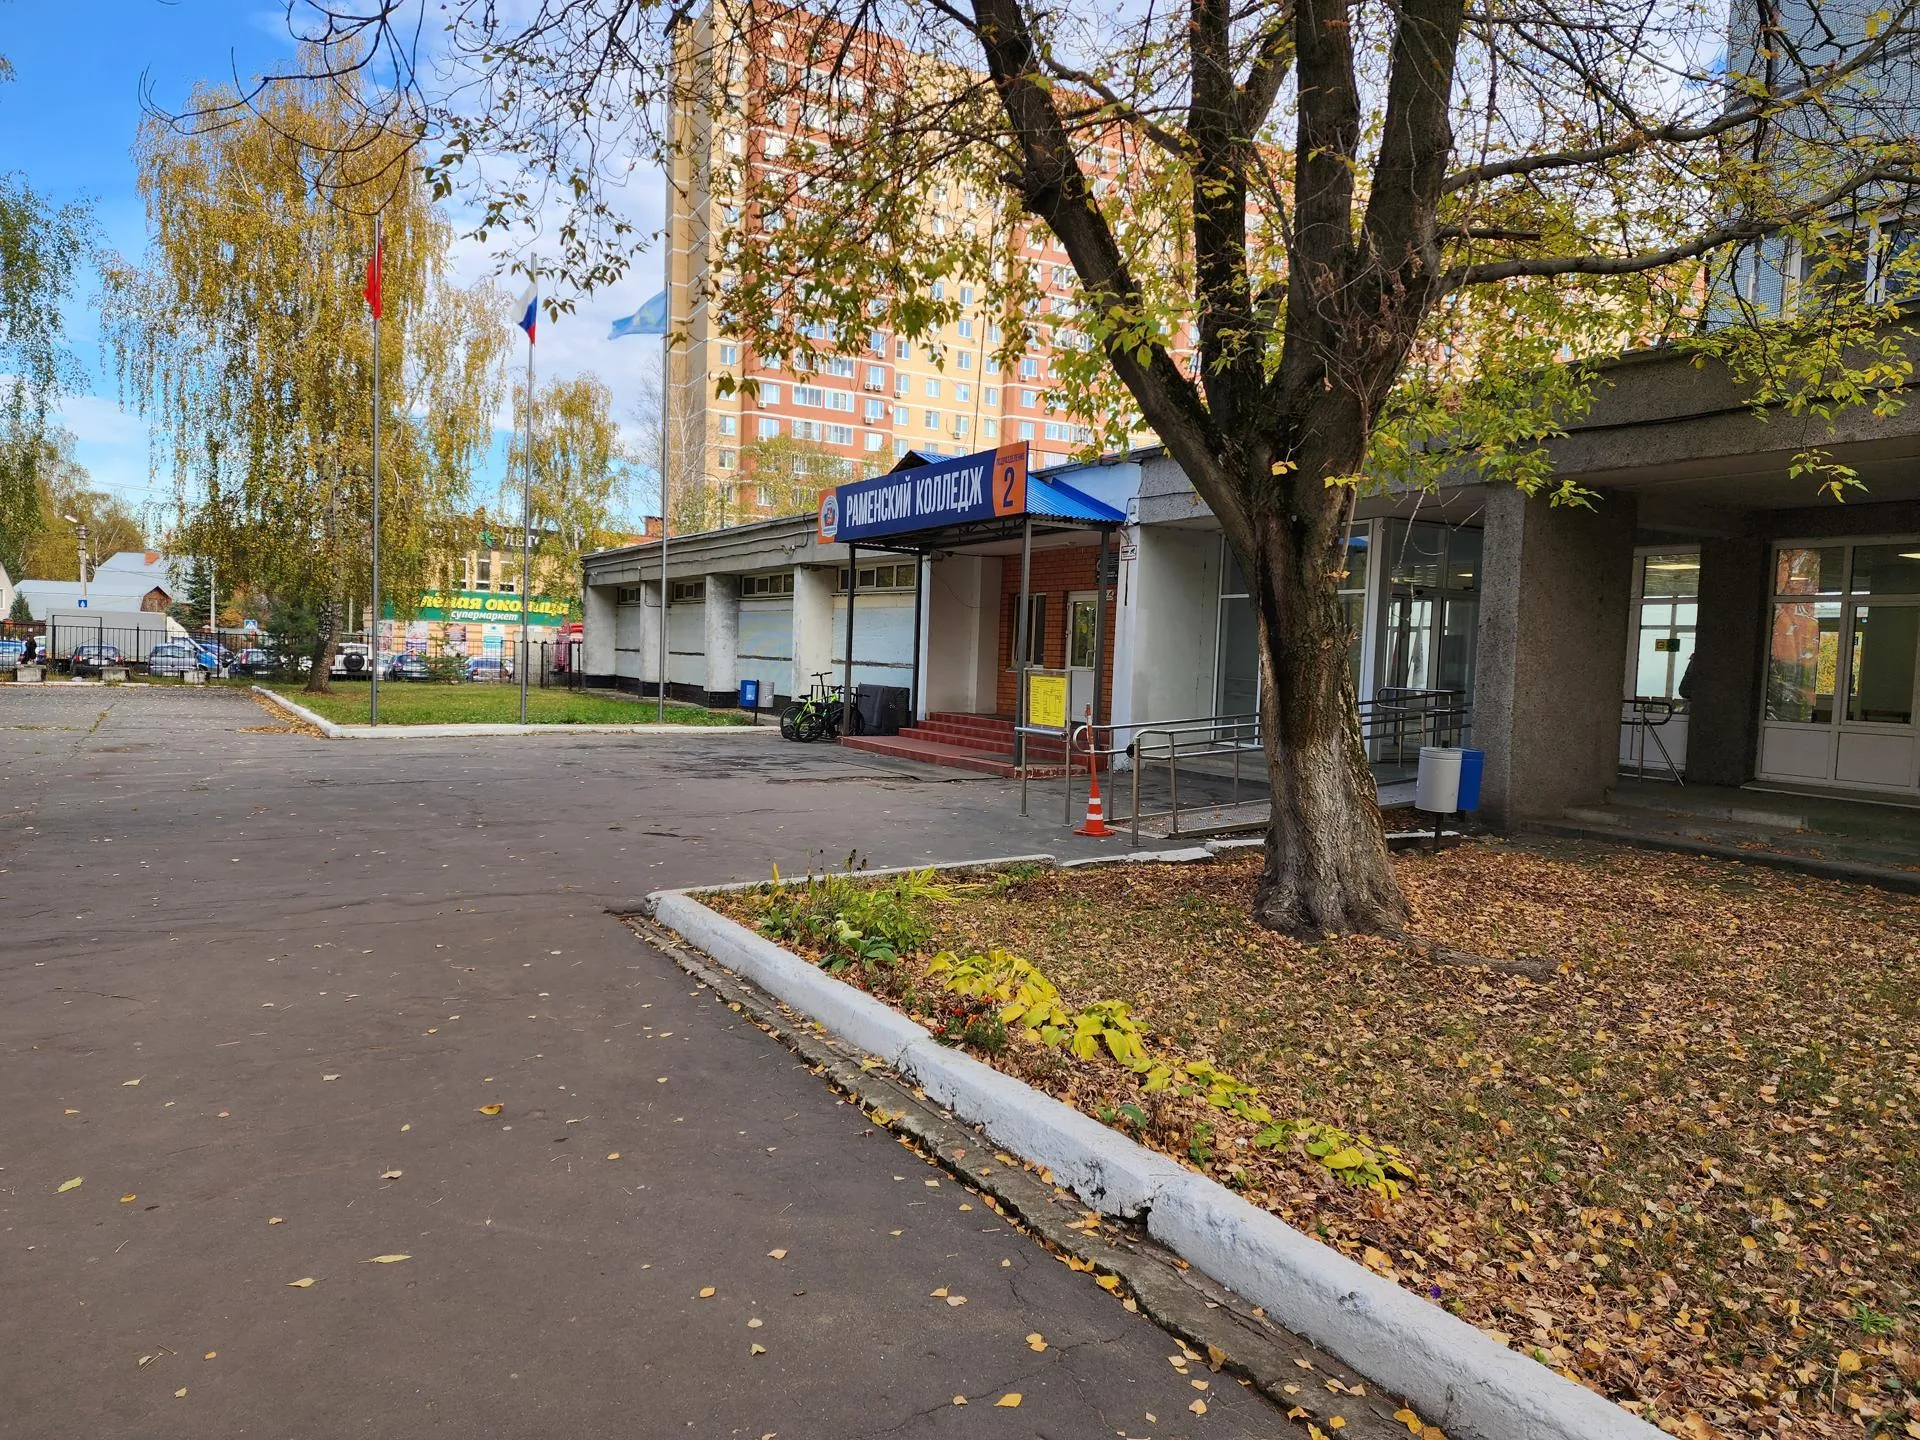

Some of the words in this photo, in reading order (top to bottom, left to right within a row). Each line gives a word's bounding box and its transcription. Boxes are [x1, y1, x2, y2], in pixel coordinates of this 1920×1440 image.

[845, 475, 912, 527] РАМЕНСКИЙ
[915, 466, 984, 515] КОЛЛЕДЖ
[1003, 467, 1015, 508] 2
[451, 610, 518, 622] супермаркет
